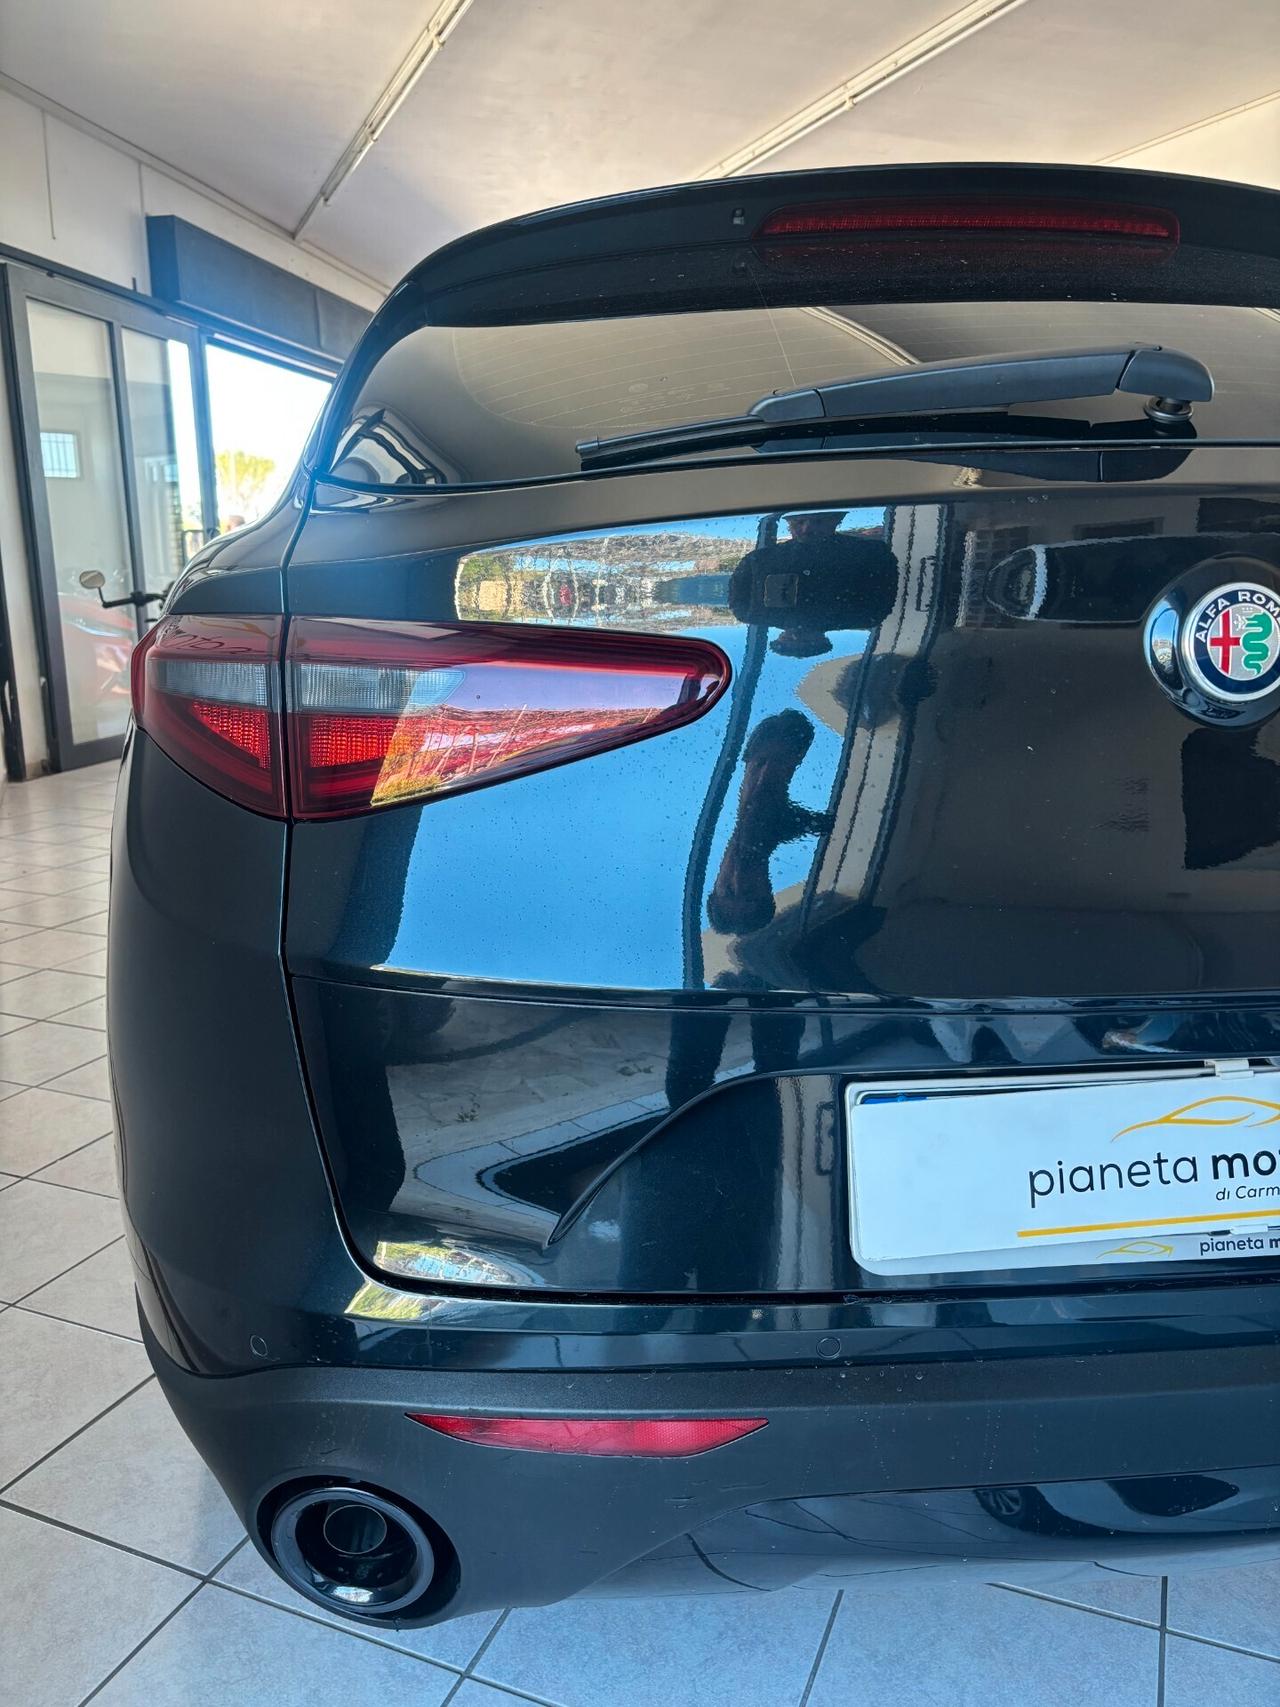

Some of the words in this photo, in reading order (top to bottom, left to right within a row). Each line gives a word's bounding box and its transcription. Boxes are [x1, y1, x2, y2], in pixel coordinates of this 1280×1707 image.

[1195, 598, 1231, 643] ALFA
[1028, 1151, 1199, 1209] pianeta
[1211, 1149, 1280, 1181] mo
[1215, 1187, 1230, 1201] di
[1199, 1237, 1264, 1257] pianeta
